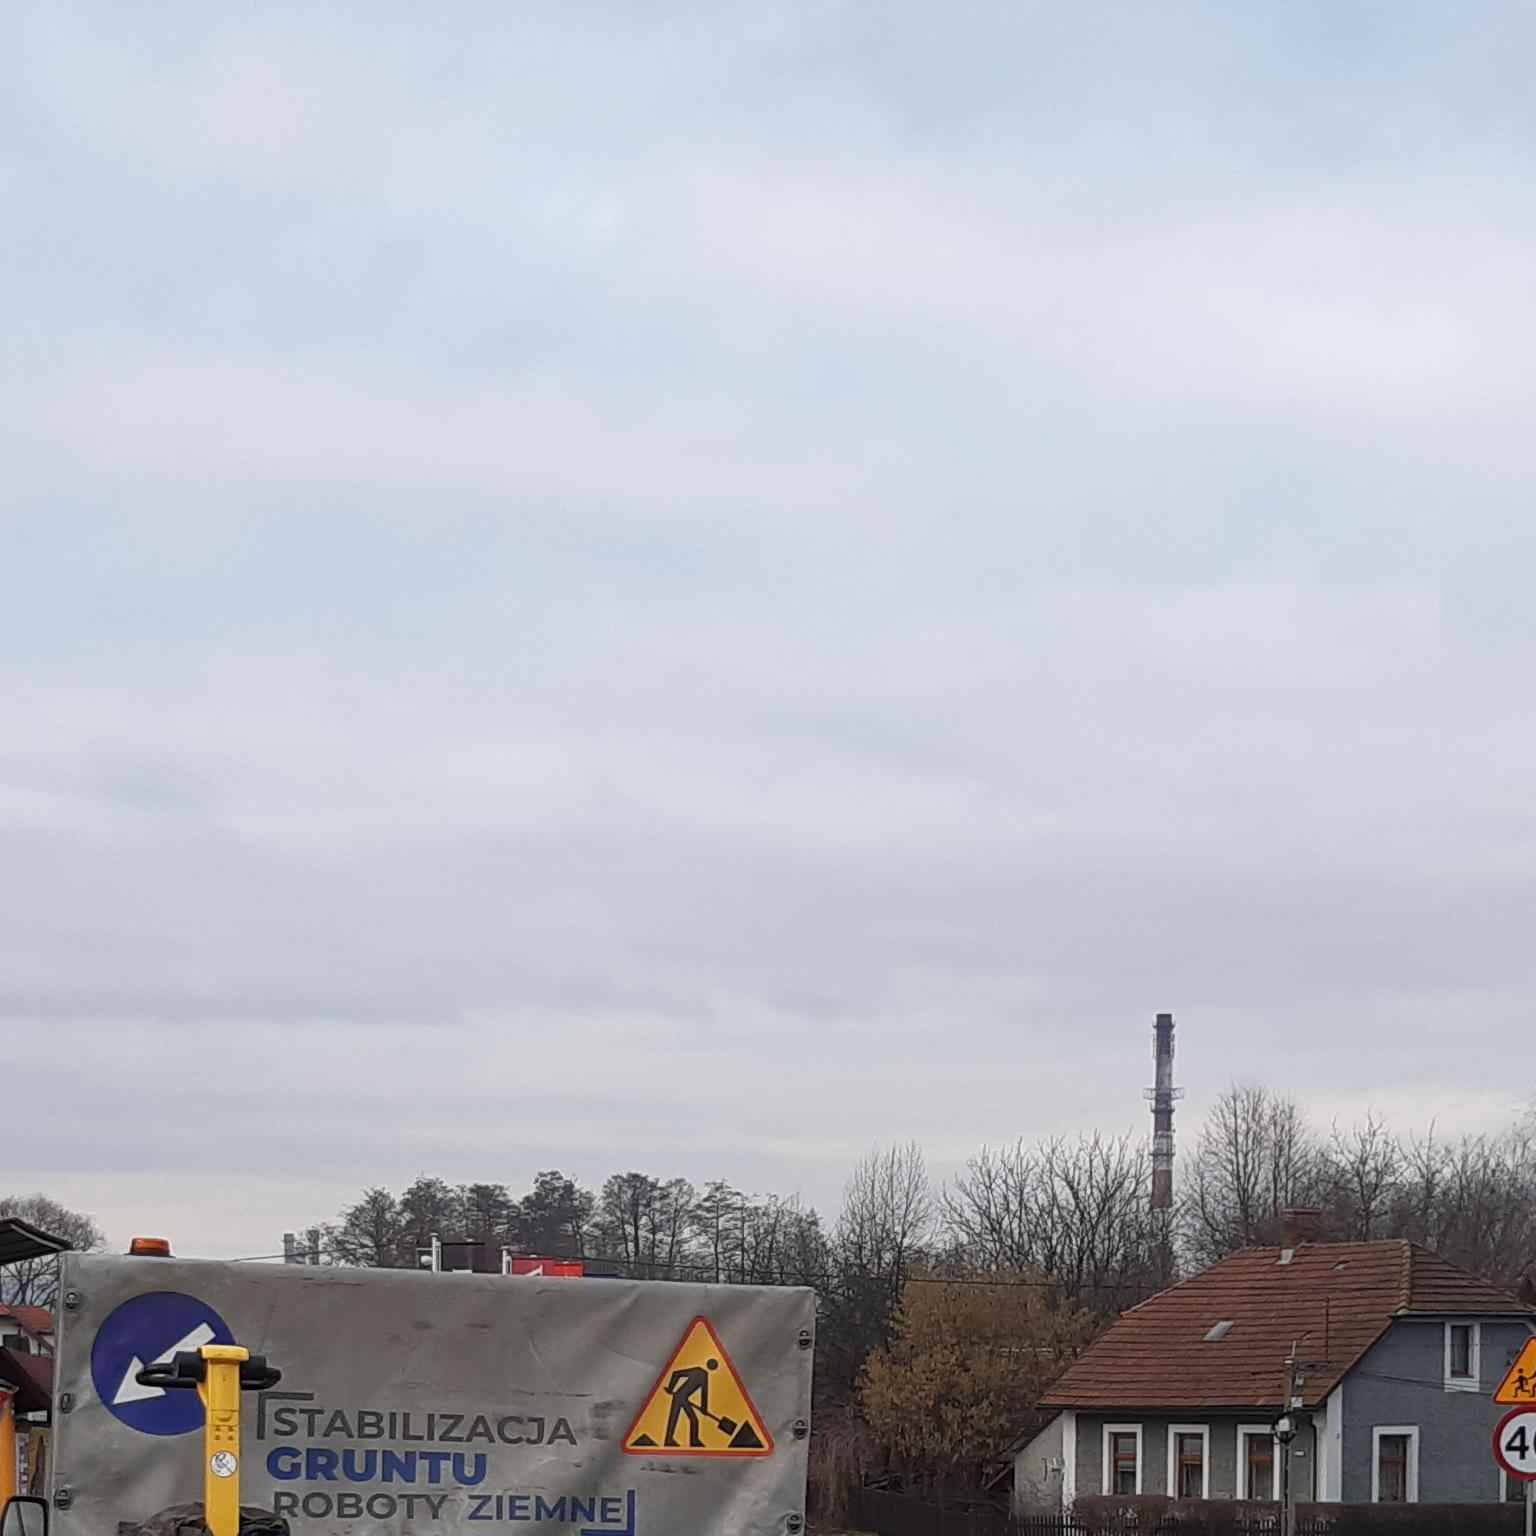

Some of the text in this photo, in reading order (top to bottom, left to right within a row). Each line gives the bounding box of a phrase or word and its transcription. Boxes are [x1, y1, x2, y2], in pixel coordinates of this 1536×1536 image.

[273, 1407, 577, 1446] STABILIZACJA
[266, 1446, 488, 1486] GRUNTU
[274, 1491, 623, 1524] ROBOTY ZIEMNE
